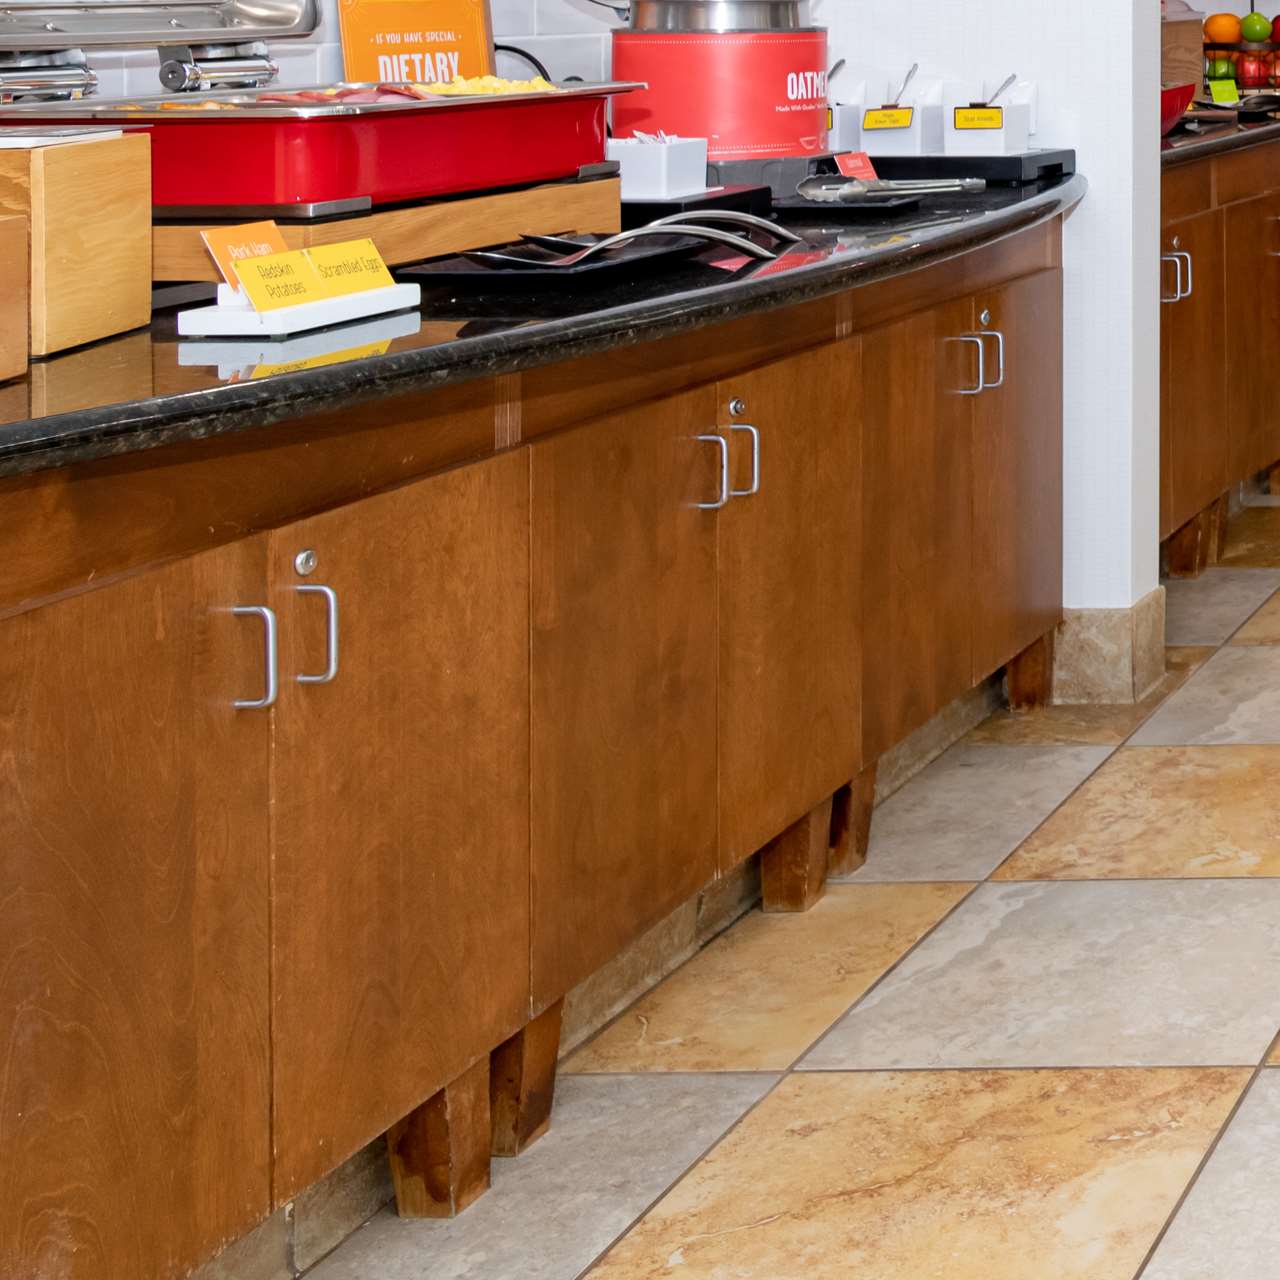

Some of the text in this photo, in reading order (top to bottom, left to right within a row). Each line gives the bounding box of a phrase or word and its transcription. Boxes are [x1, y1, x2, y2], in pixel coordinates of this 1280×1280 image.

[375, 30, 457, 45] IF YOU HAVE SPECIAL
[377, 51, 459, 83] DIETARY
[227, 243, 254, 259] Pork
[256, 262, 295, 281] Redskin
[317, 256, 382, 280] Scrambled Eggs
[264, 280, 308, 299] Potatoes
